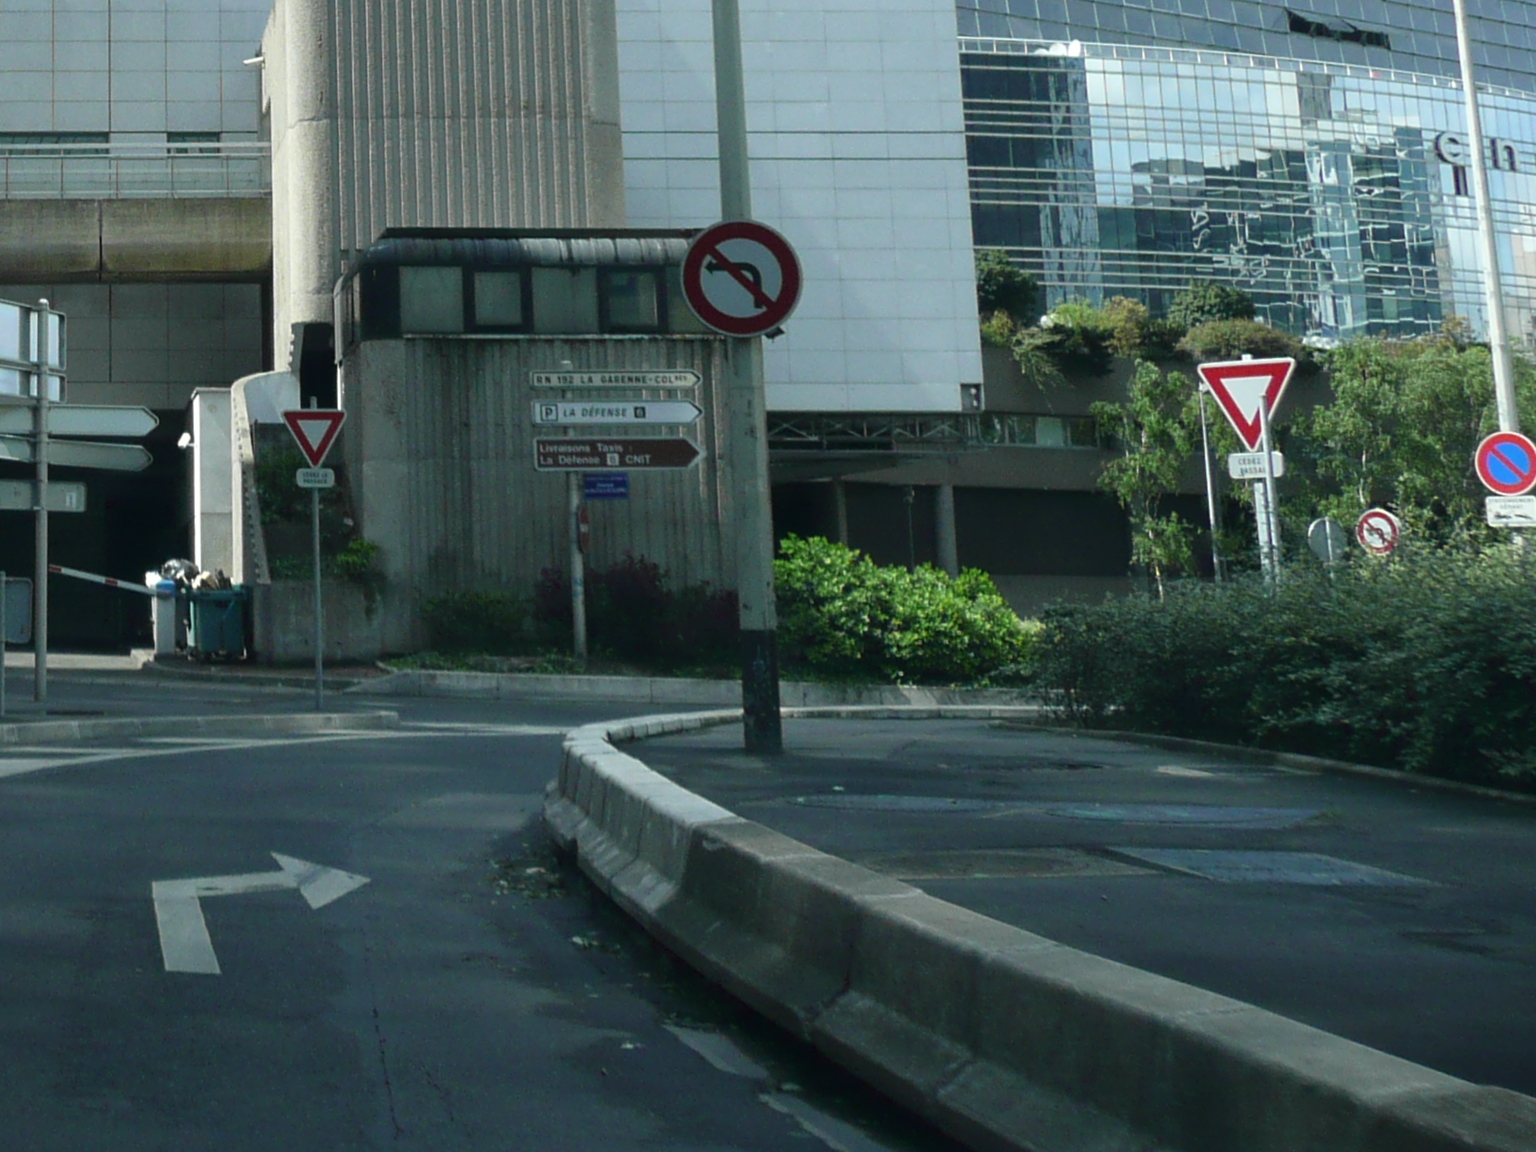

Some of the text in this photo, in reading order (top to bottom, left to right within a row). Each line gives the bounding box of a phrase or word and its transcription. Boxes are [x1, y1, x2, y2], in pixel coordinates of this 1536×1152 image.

[580, 375, 593, 385] LA
[563, 407, 576, 418] LA
[539, 442, 624, 454] Livraisons Taxis
[540, 455, 554, 466] La
